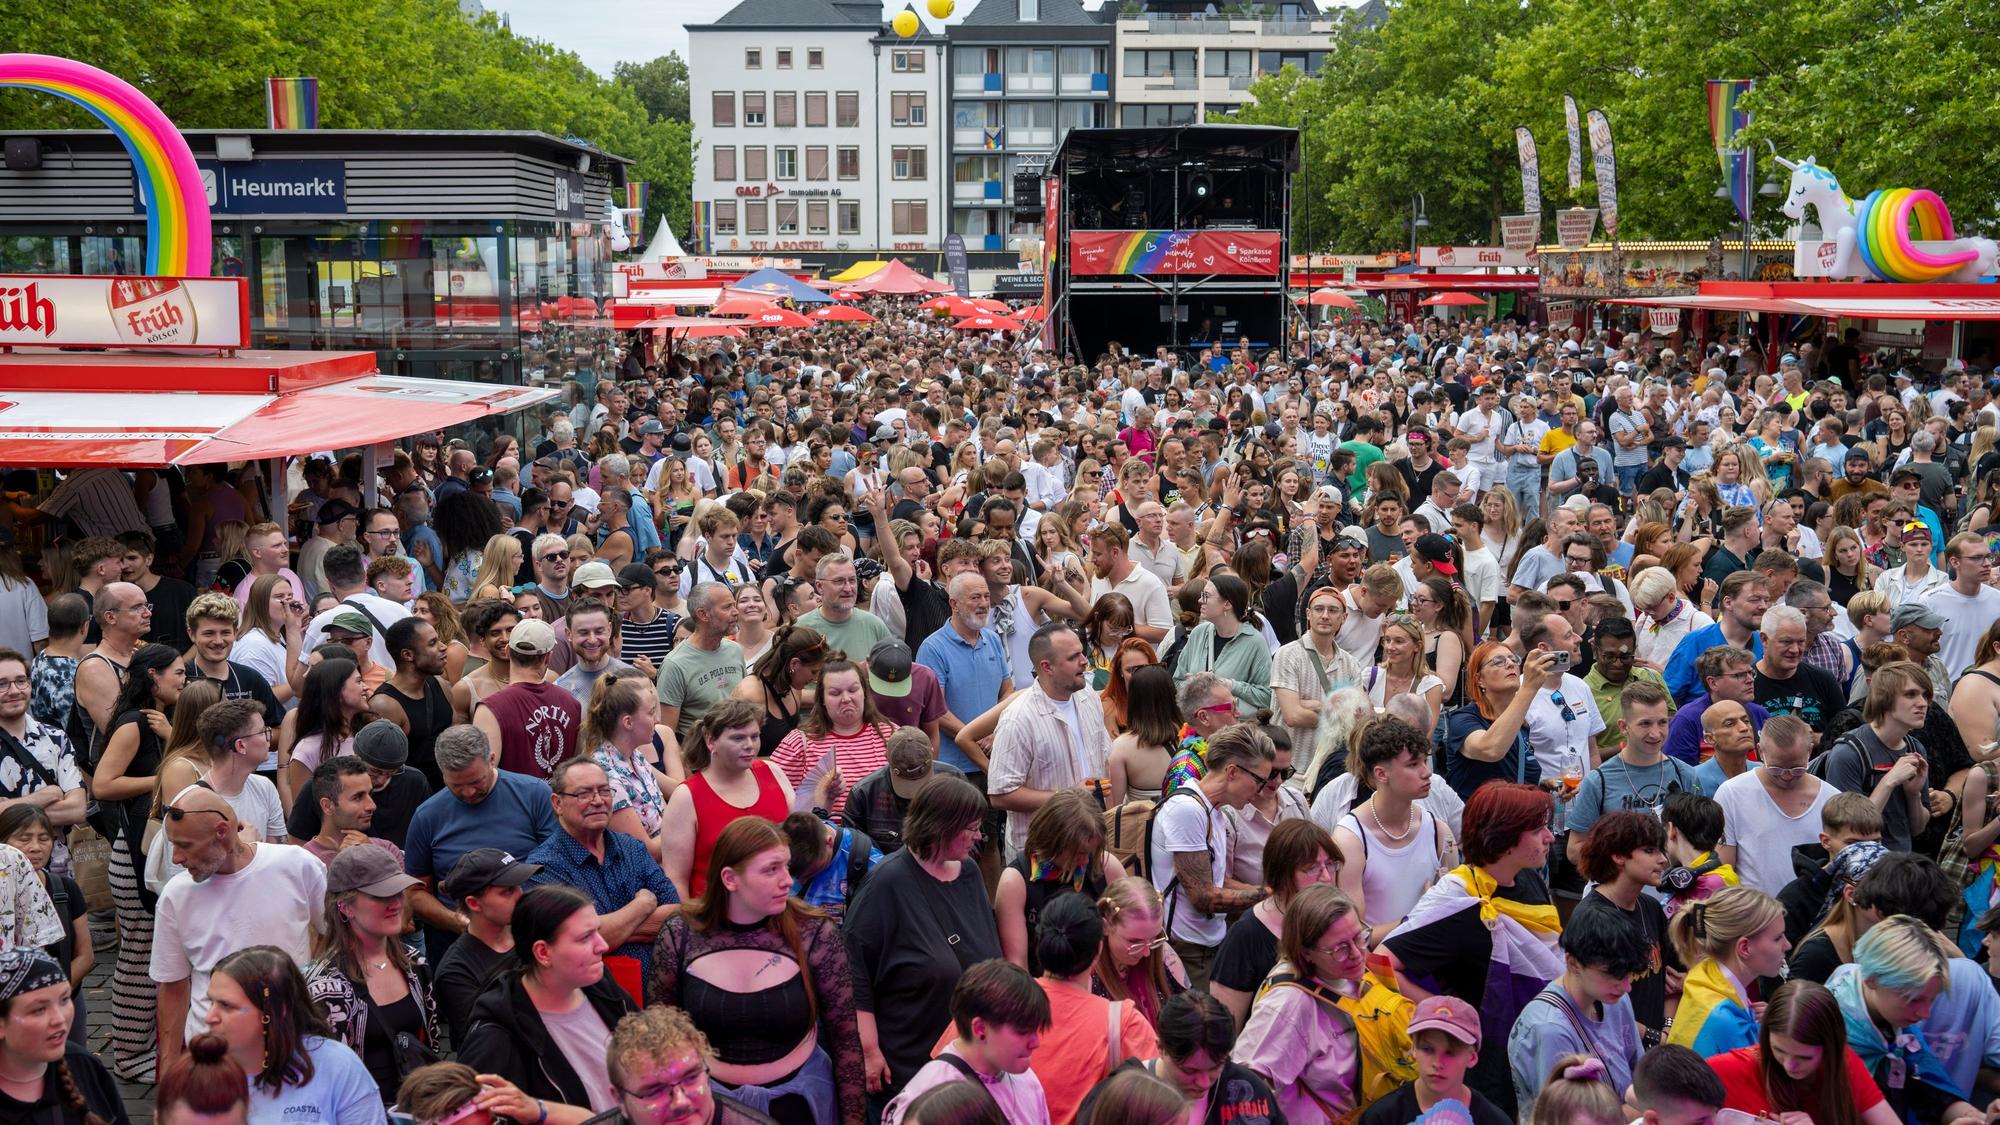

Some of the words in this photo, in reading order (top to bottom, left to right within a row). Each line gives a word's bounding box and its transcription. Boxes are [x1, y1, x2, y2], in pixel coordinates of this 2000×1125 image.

[232, 177, 335, 196] Heumarkt
[735, 186, 761, 197] GAG
[788, 189, 828, 197] Immobilien
[830, 189, 842, 197] AG
[774, 241, 825, 251] APOSTEL
[894, 242, 926, 251] HOTEL
[1239, 247, 1273, 257] Sparkasse
[1175, 257, 1198, 272] Liebe
[1239, 256, 1271, 264] KölnBonn
[1651, 312, 1679, 326] STEAKS
[147, 328, 179, 343] KÖLSCH
[698, 673, 710, 686] U.S.
[709, 667, 724, 680] POLO
[1763, 697, 1781, 709] EY
[1786, 695, 1821, 706] WST
[525, 704, 571, 737] NORTH
[73, 852, 97, 863] REWE
[311, 981, 343, 997] APAN
[284, 1105, 321, 1114] COASTAL
[1221, 1098, 1270, 1125] paranoid
